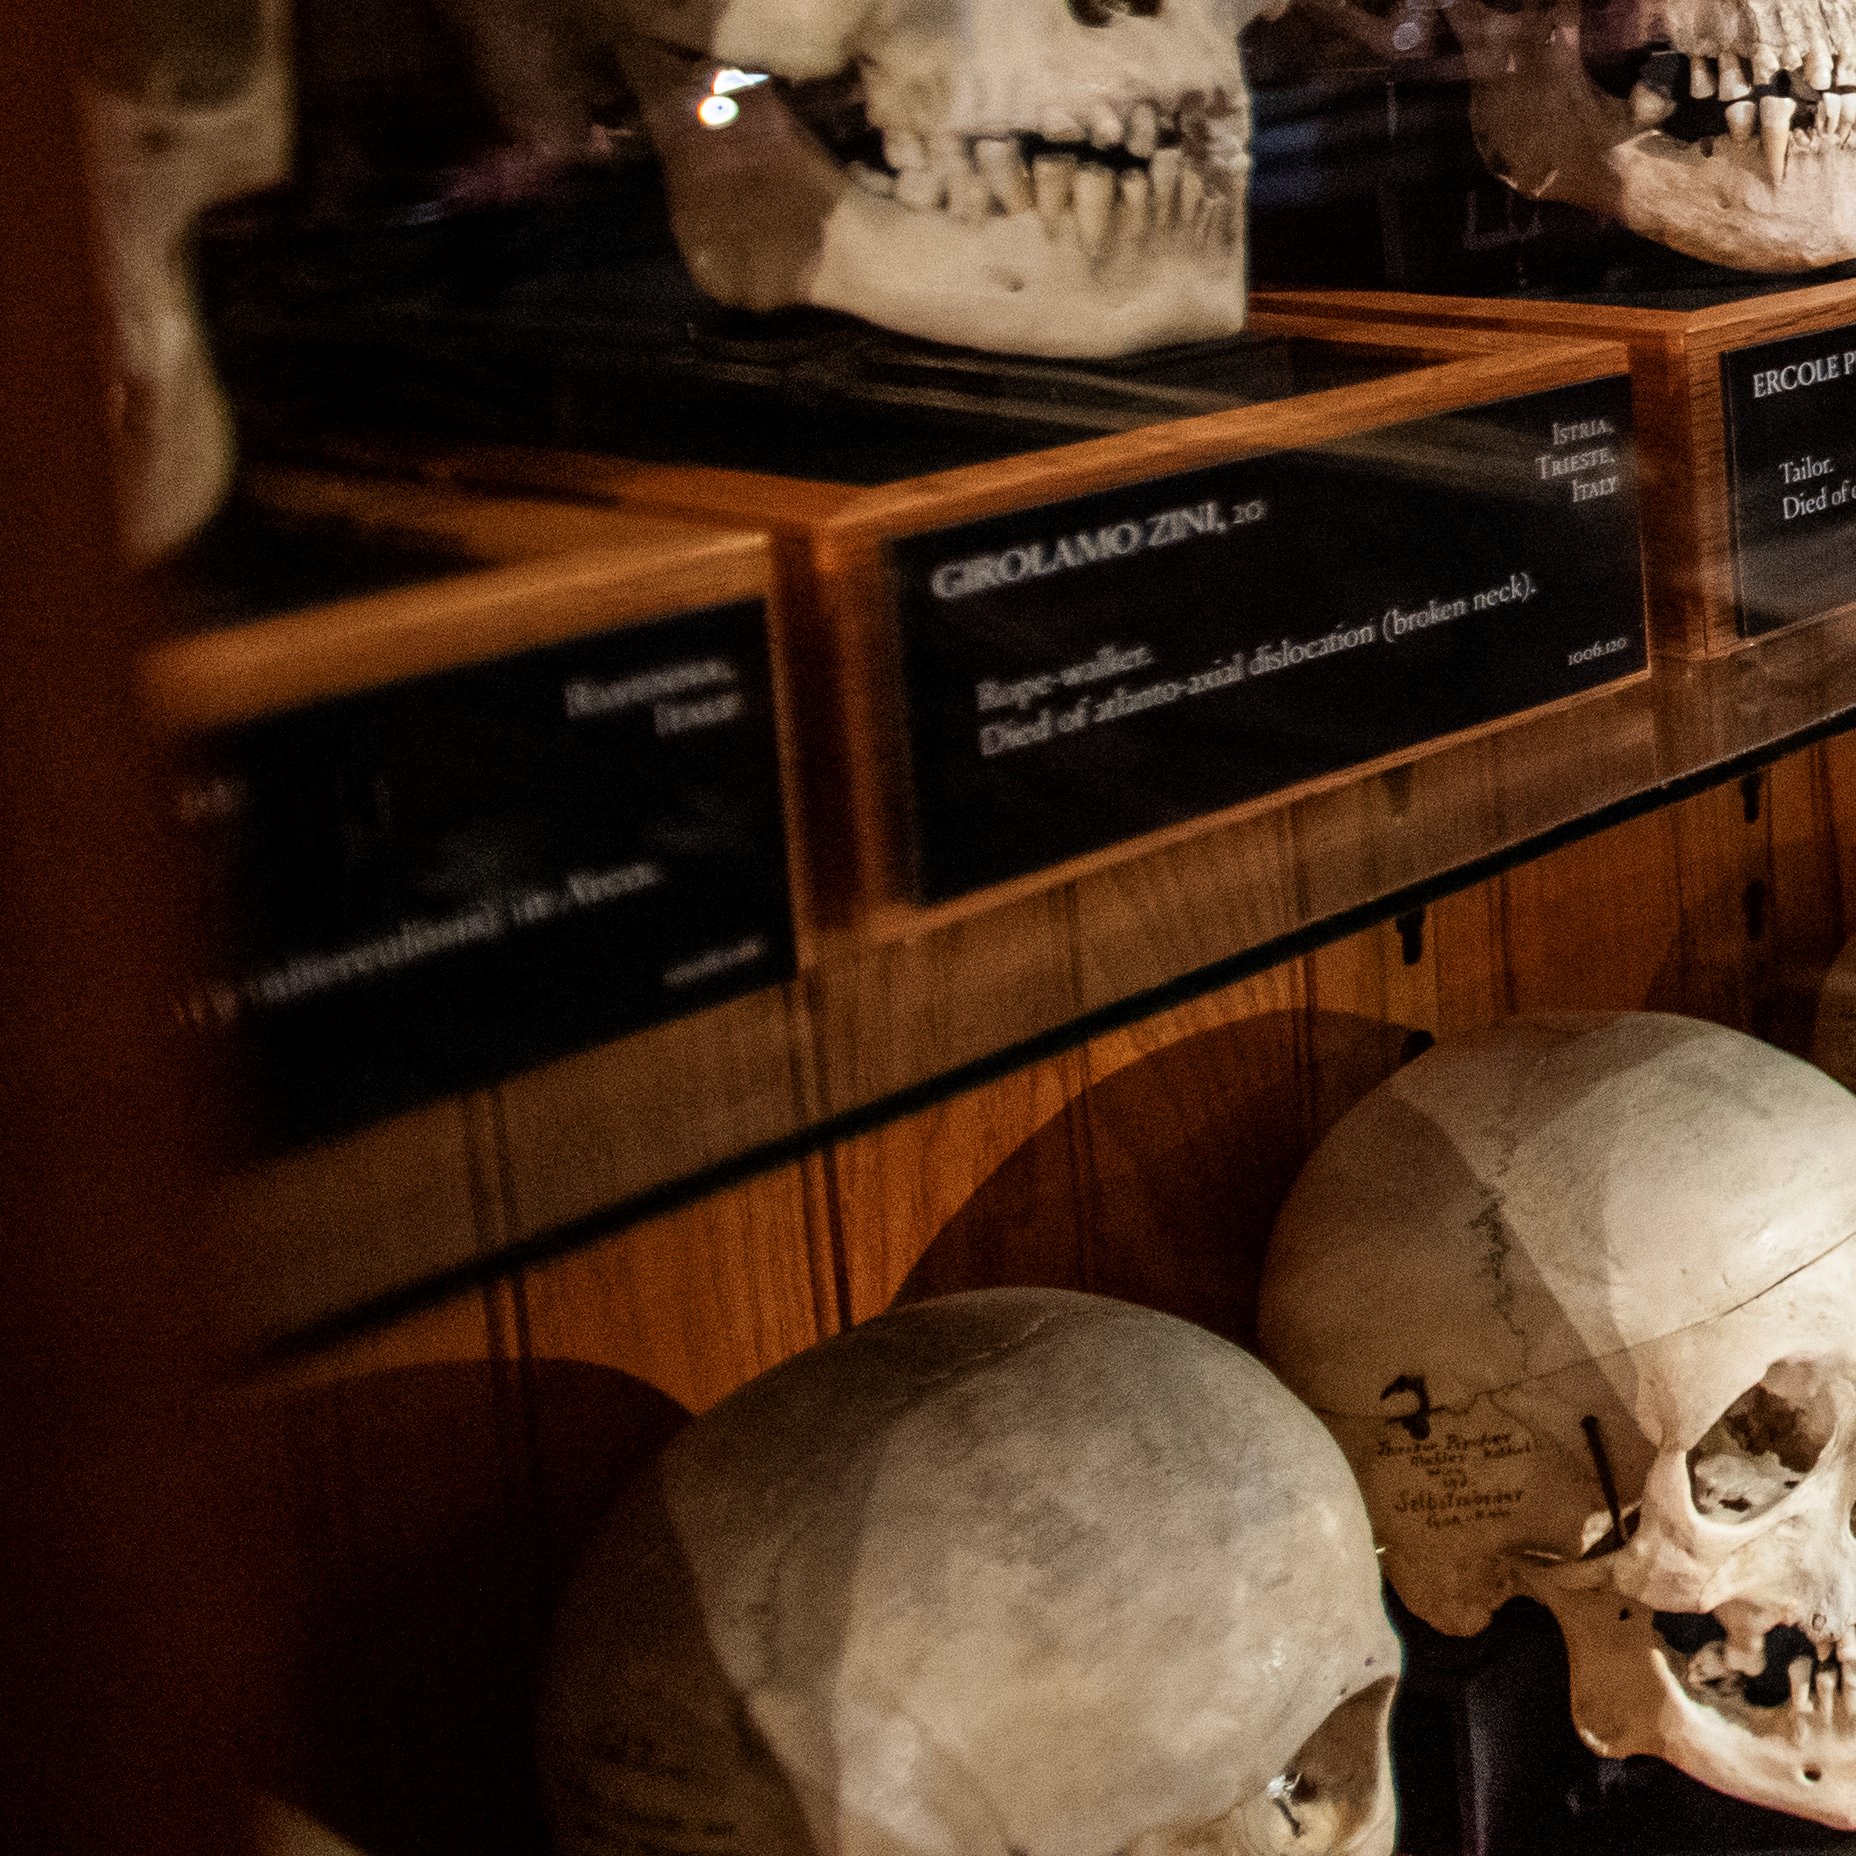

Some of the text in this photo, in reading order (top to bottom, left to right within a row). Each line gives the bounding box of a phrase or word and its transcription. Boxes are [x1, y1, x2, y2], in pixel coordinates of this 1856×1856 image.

[1752, 353, 1840, 400] ERCOLE
[1552, 418, 1616, 446] ISTRIA,
[1533, 445, 1617, 481] TRIESTE,
[1778, 454, 1836, 486] Tailor.
[1570, 474, 1621, 504] ITALY
[1781, 485, 1828, 521] Died
[1829, 478, 1851, 507] of
[929, 497, 1269, 602] GIROLAMO ZINI, 20
[978, 706, 1052, 759] Died
[1056, 694, 1092, 734] of
[1248, 617, 1377, 677] dislocation
[1381, 597, 1468, 644] (broken
[1472, 570, 1539, 604] neck).
